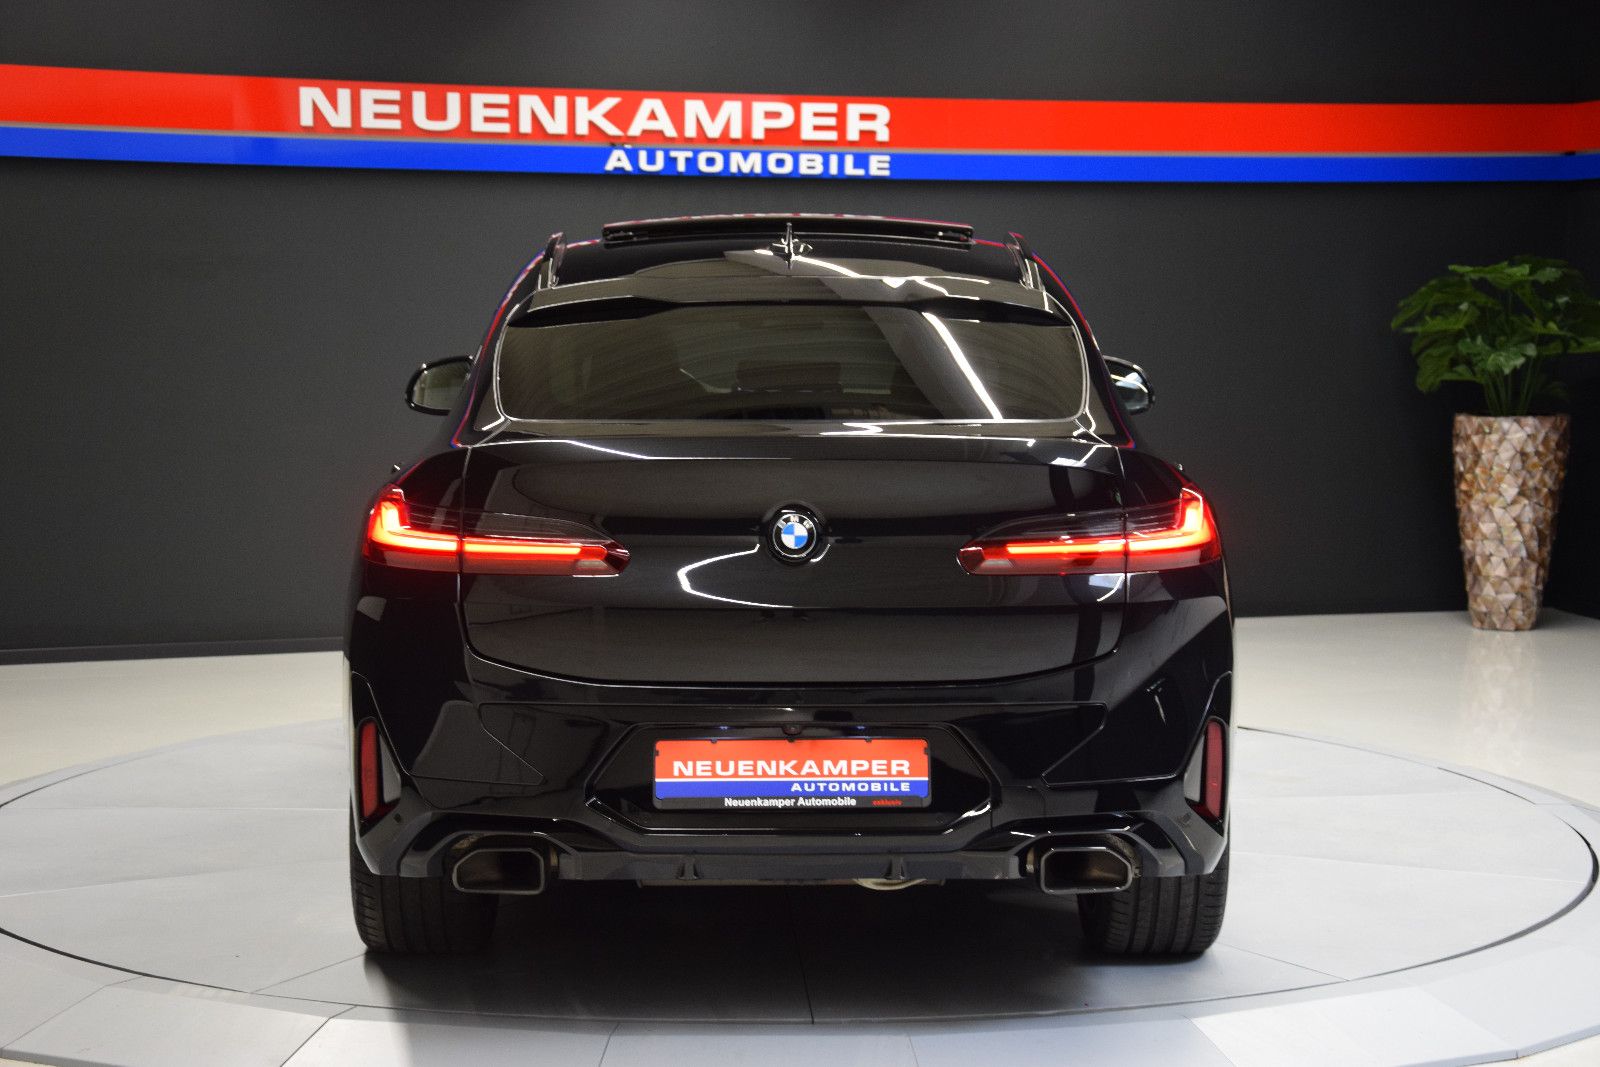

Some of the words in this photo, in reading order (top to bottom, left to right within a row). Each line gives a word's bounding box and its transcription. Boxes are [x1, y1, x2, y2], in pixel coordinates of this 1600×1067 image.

[299, 86, 892, 143] NEUENKAMPER
[604, 147, 891, 177] AUTOMOBILE
[673, 759, 910, 776] NEUENKAMPER
[790, 782, 911, 792] AUTOMOBILE
[724, 797, 796, 808] Neuenkamper
[797, 796, 856, 806] Automobile
